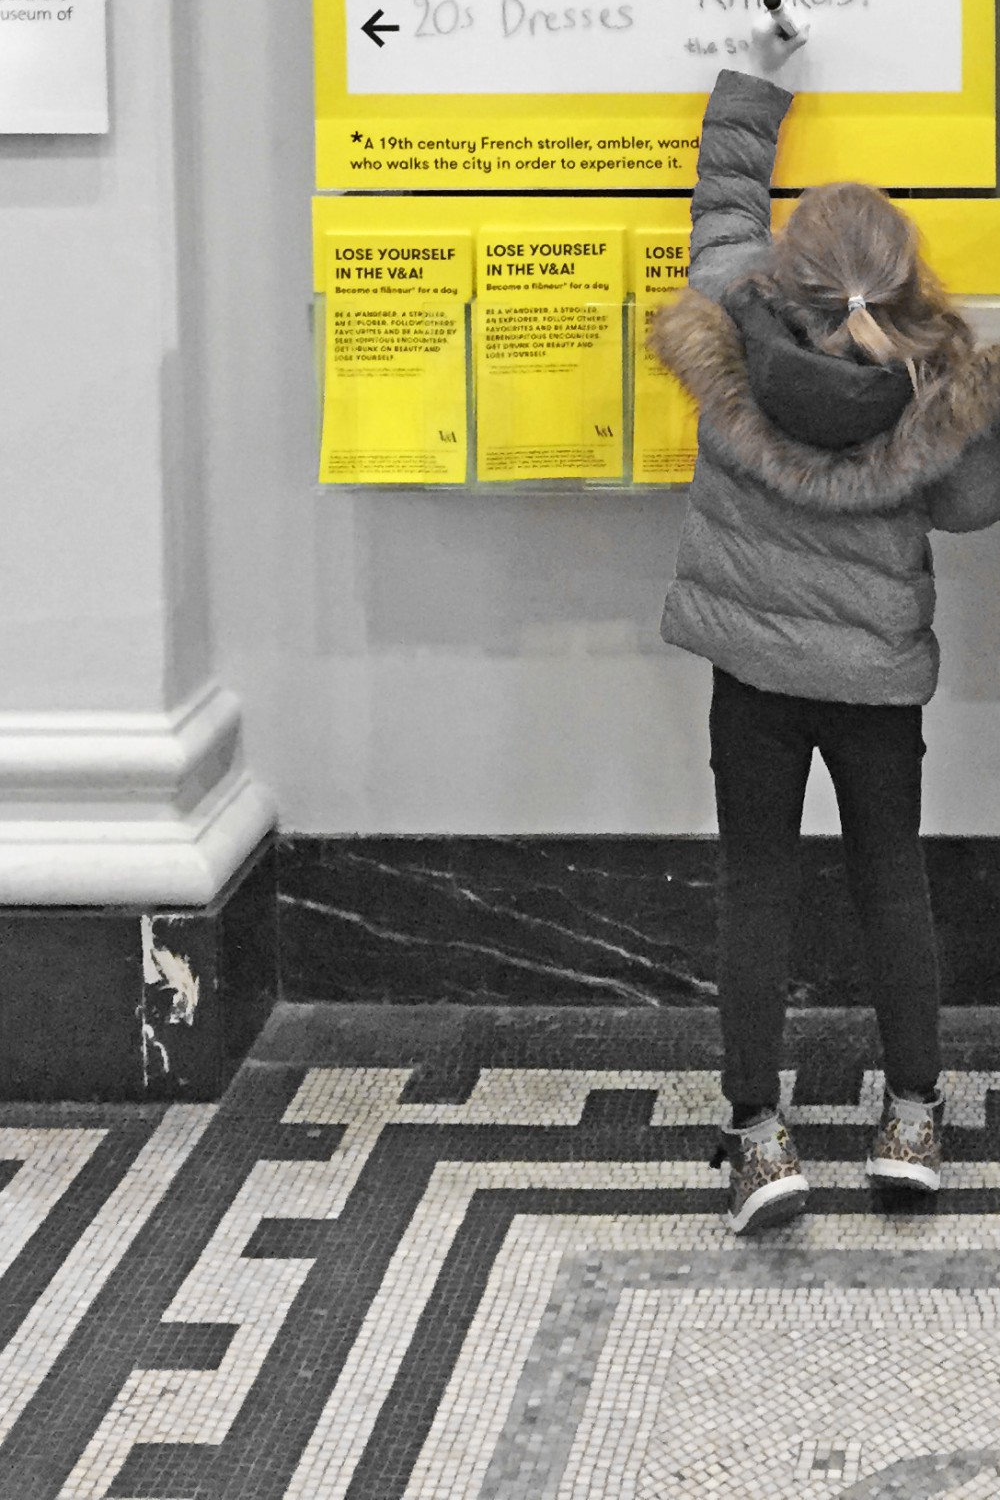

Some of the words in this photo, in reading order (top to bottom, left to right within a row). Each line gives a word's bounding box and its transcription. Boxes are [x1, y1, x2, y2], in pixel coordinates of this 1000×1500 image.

[57, 6, 73, 21] of
[380, 137, 413, 149] 19th
[418, 138, 476, 153] century
[481, 136, 533, 150] French
[538, 137, 592, 151] stroller,
[597, 136, 653, 151] ambler,
[350, 157, 382, 170] who
[386, 157, 429, 170] walks
[434, 157, 458, 169] the
[463, 157, 491, 173] city
[497, 157, 510, 169] in
[515, 157, 556, 169] order
[561, 158, 575, 169] to
[580, 157, 663, 172] experience
[668, 156, 682, 169] it.
[335, 248, 373, 260] LOSE
[377, 248, 455, 260] YOURSELF
[486, 244, 524, 257] LOSE
[529, 243, 606, 256] YOURSELF
[646, 246, 683, 259] LOSE
[336, 268, 351, 279] IN
[355, 267, 383, 279] THE
[387, 267, 423, 279] V&A!
[487, 264, 502, 276] IN
[506, 263, 534, 276] THE
[539, 262, 574, 275] V&A!
[646, 266, 661, 278] IN
